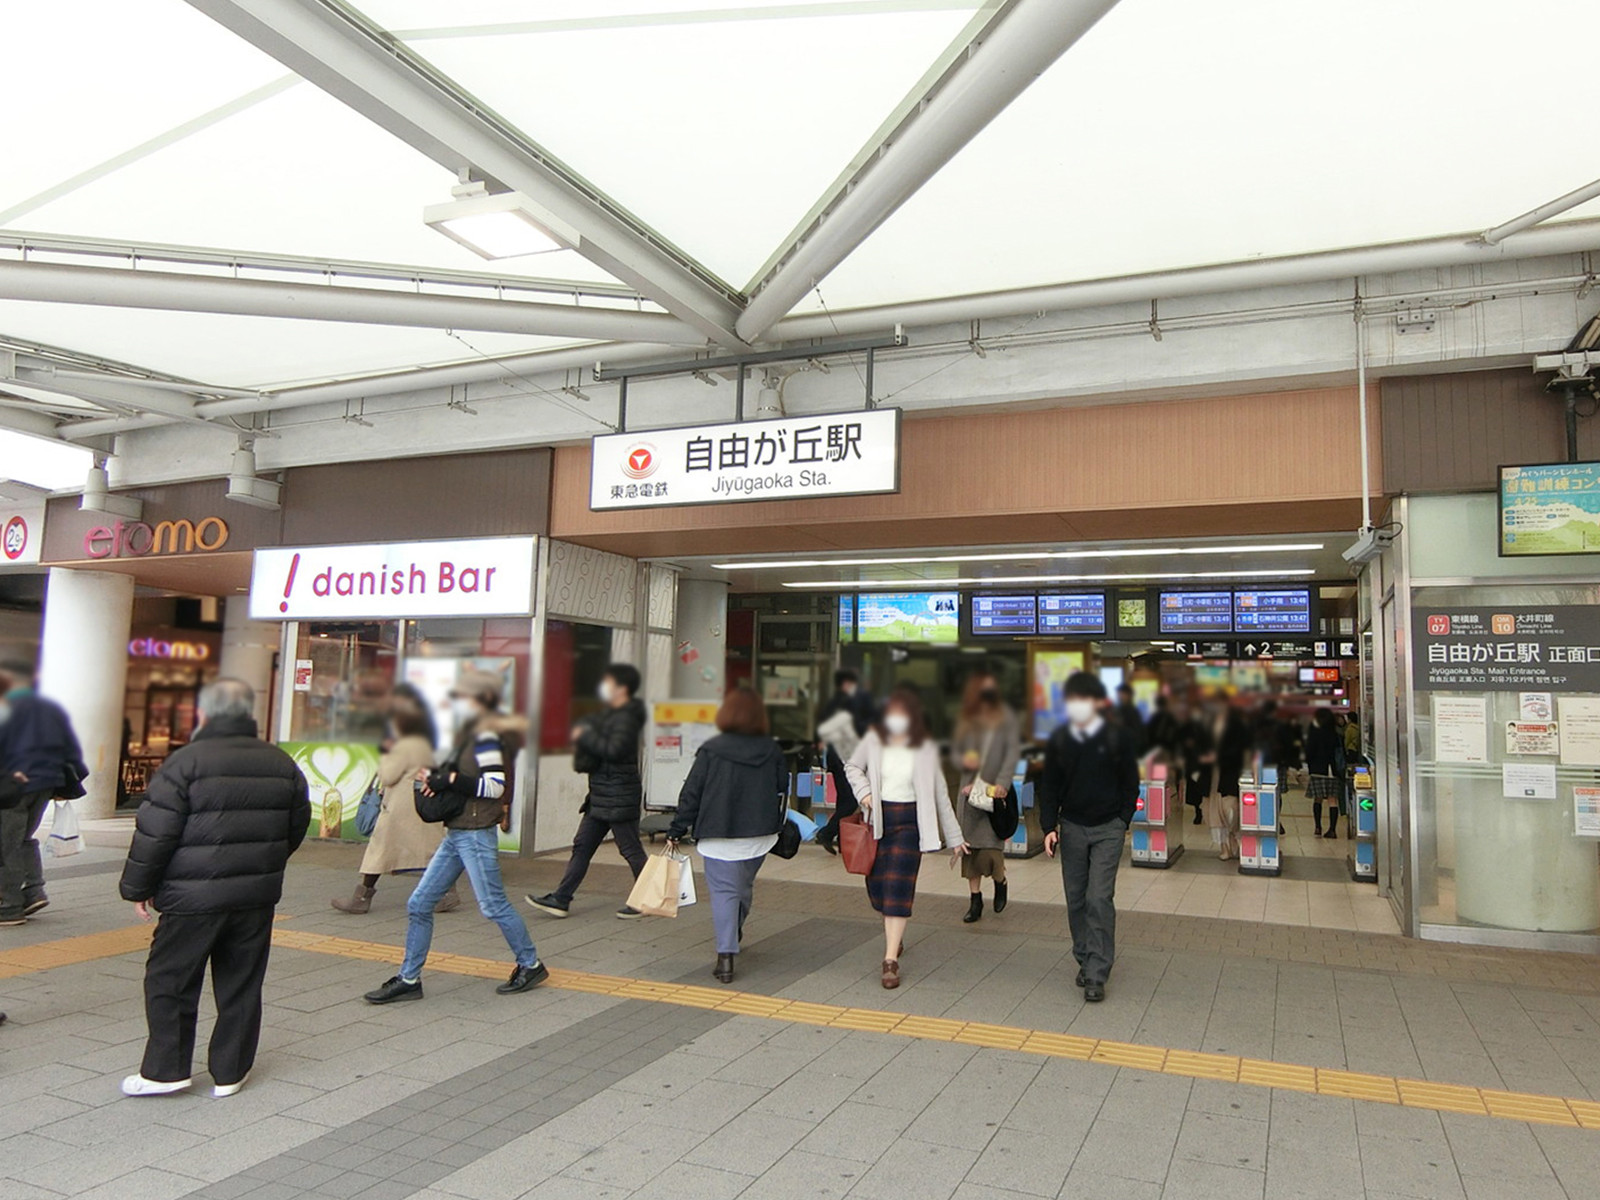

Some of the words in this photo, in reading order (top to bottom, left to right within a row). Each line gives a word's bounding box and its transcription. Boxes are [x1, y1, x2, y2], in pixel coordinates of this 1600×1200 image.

[686, 423, 862, 473] 自由が丘駅
[610, 481, 668, 499] 東急電鉄
[712, 473, 793, 496] Jiyūgaoka
[799, 470, 832, 486] Sta.
[83, 517, 229, 558] etomo
[312, 563, 426, 597] danish
[438, 561, 496, 593] Bar
[1451, 615, 1479, 623] 東横線
[1516, 614, 1554, 623] 大井町線
[1431, 623, 1445, 633] 07
[1496, 623, 1510, 632] 10
[1260, 642, 1271, 654] 2
[1428, 643, 1540, 663] 自由が丘駅
[1488, 667, 1507, 675] Main
[1509, 667, 1546, 675] Entrance
